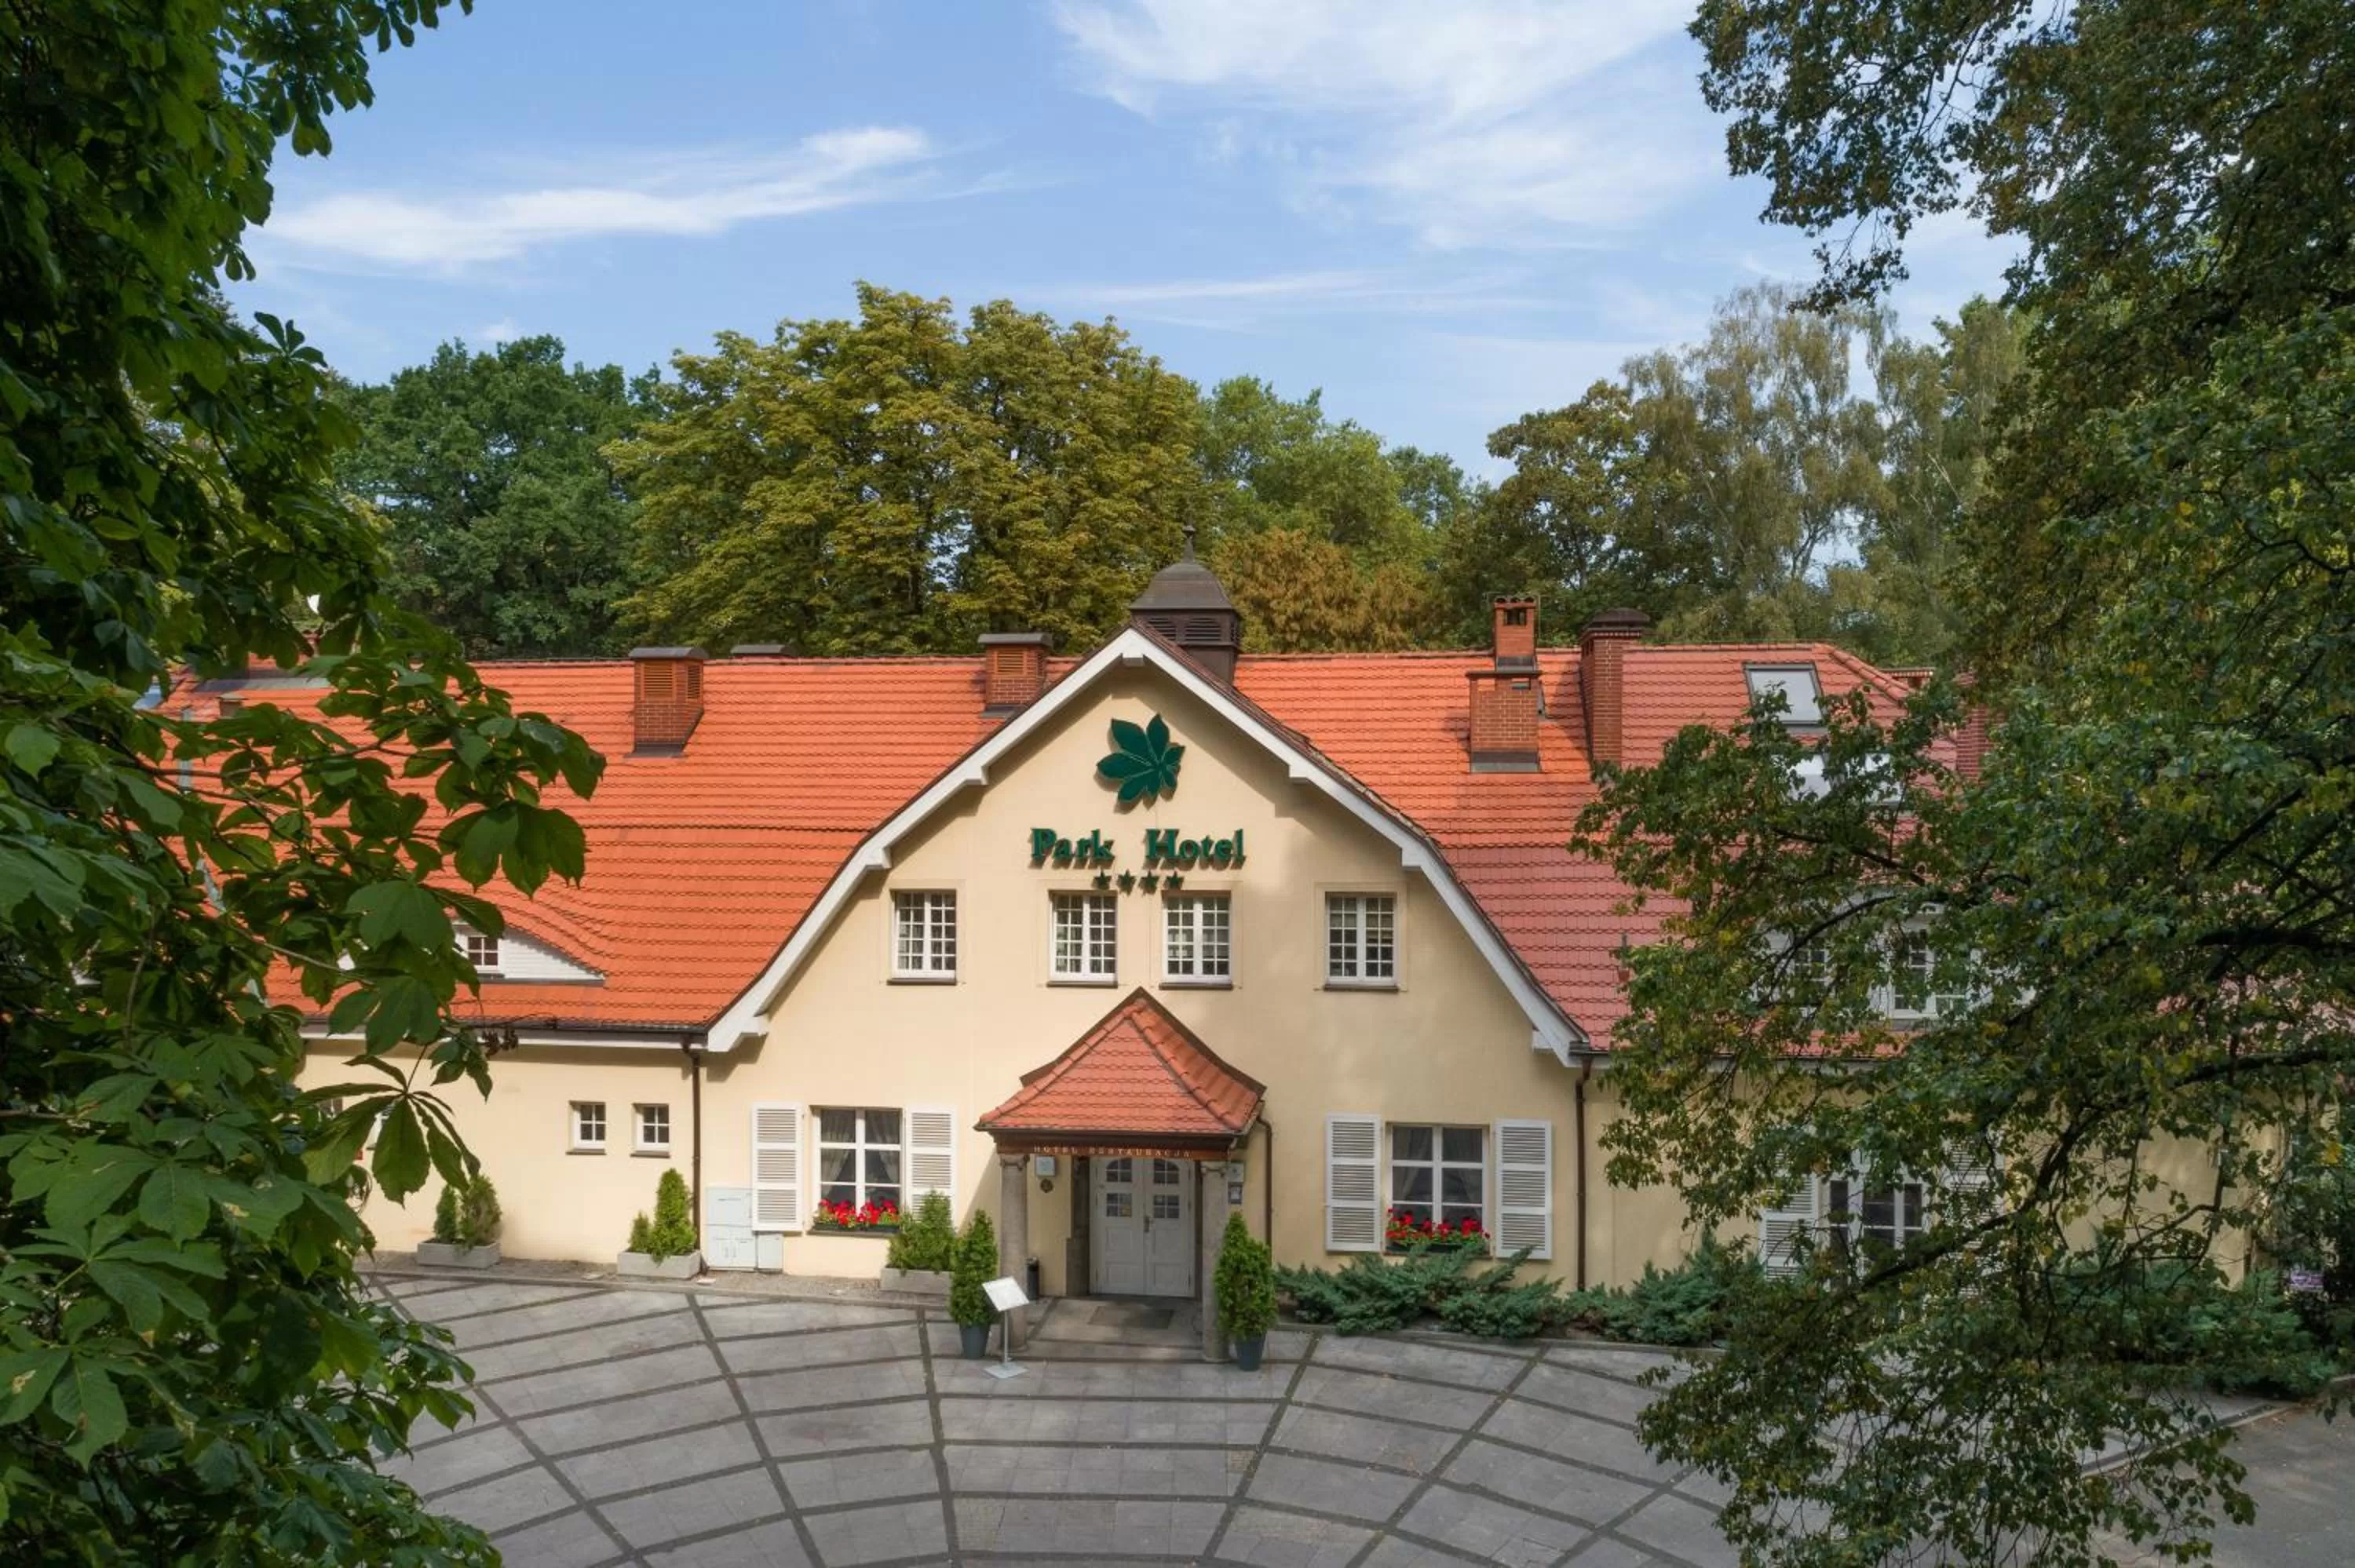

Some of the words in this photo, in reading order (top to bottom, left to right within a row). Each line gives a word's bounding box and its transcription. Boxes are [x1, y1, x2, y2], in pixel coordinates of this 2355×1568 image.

[1031, 827, 1114, 859] Park
[1145, 827, 1245, 859] Hotel
[1033, 1146, 1078, 1154] HOTEL
